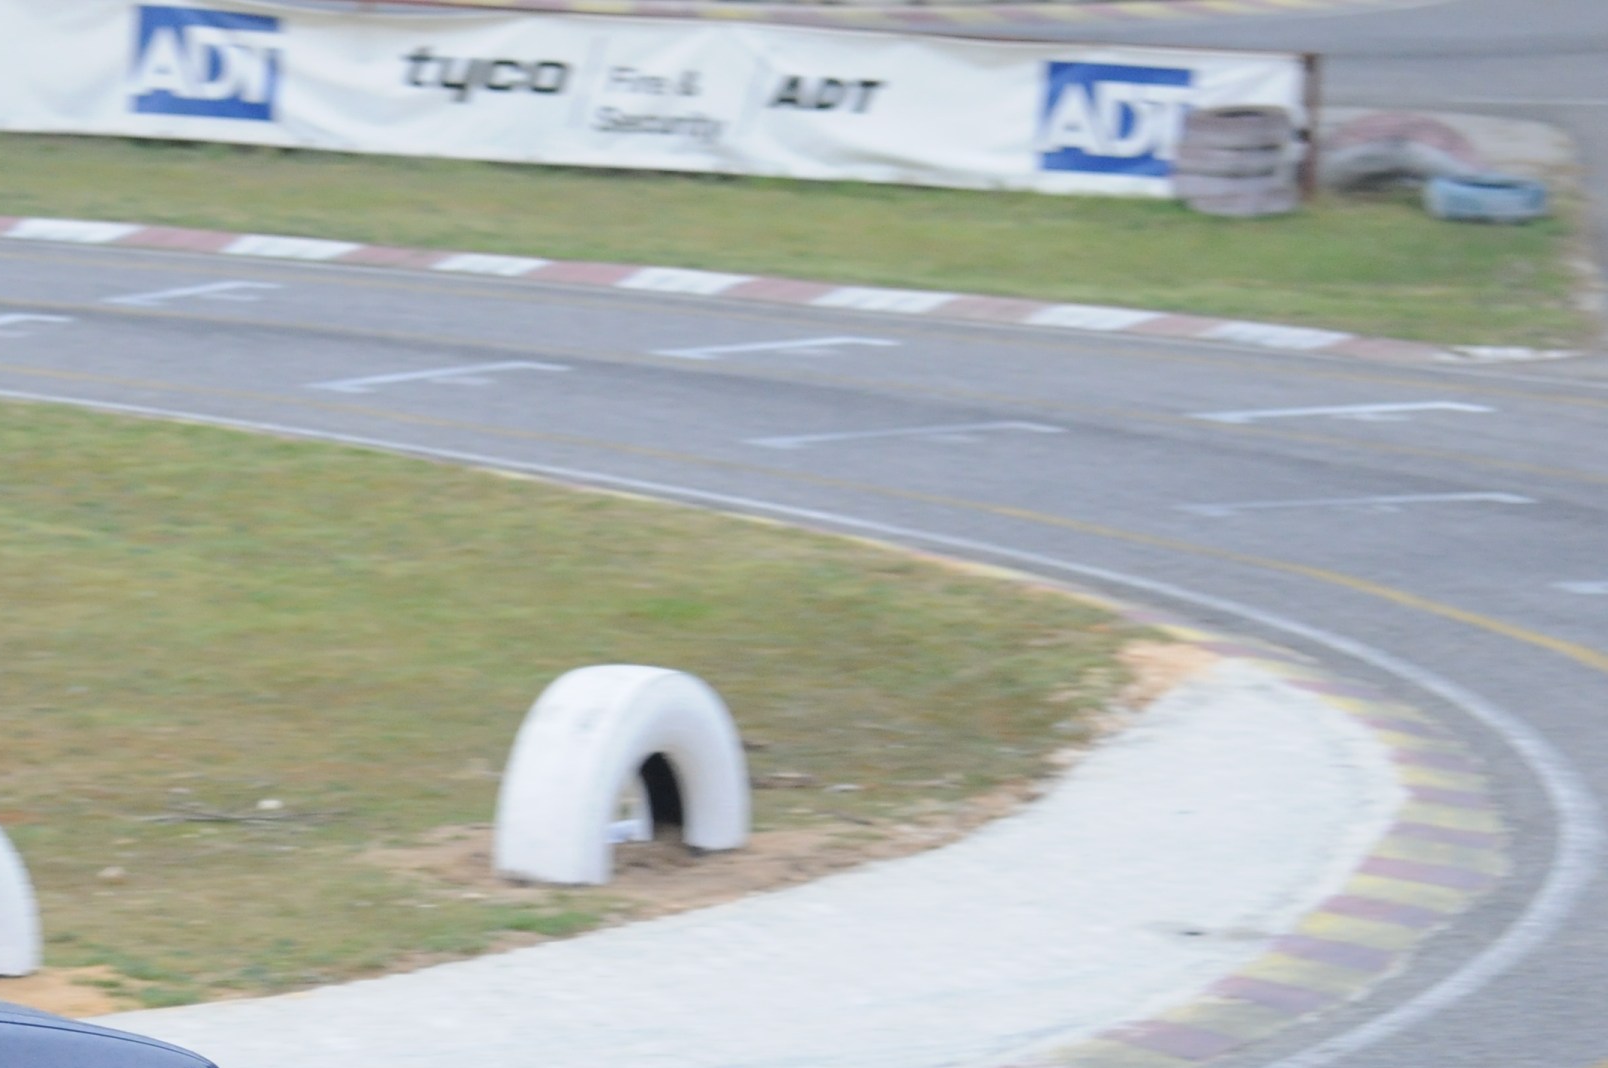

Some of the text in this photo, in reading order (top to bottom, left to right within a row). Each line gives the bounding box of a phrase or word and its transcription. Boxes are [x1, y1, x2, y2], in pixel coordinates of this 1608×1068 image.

[130, 24, 289, 103] ADT
[400, 46, 574, 102] tyco
[765, 75, 888, 114] ADT
[1042, 80, 1198, 160] ADT
